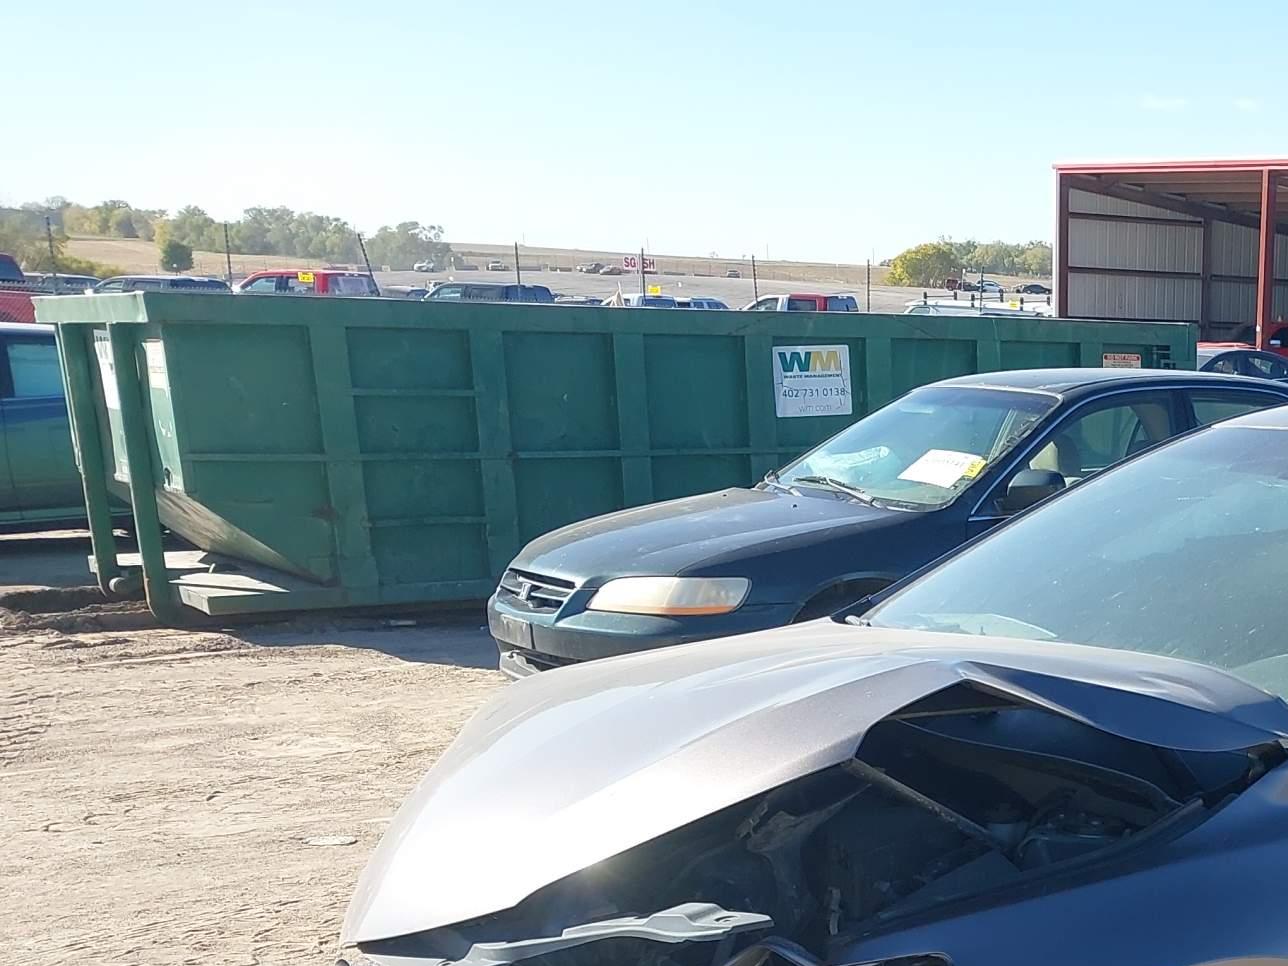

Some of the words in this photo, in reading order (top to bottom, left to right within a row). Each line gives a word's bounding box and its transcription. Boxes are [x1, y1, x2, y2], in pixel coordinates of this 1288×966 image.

[778, 351, 841, 372] WM
[782, 388, 800, 398] 402
[802, 388, 819, 398] 731
[822, 387, 846, 397] 0138
